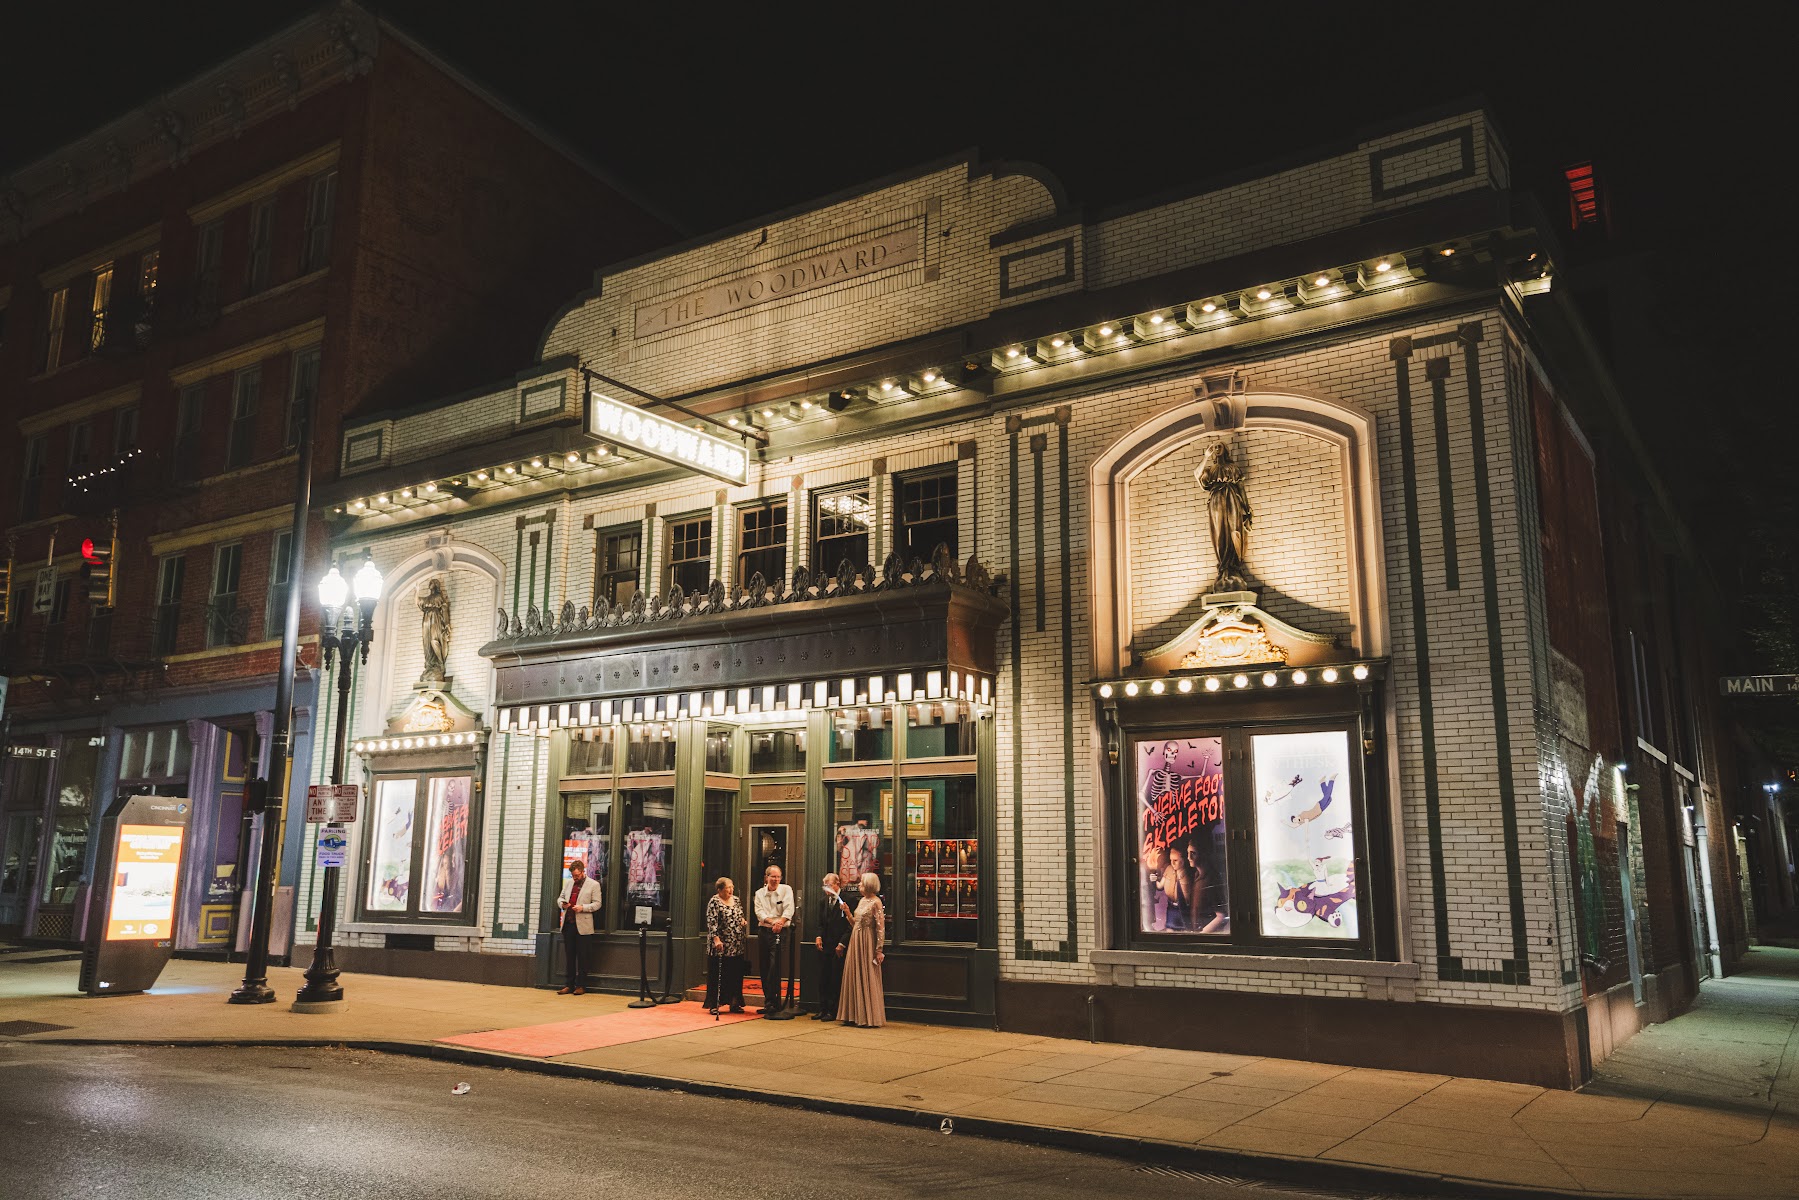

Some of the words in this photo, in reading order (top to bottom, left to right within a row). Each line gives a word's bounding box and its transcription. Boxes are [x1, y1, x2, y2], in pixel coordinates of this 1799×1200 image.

[660, 296, 705, 325] THE
[727, 243, 888, 305] WOODWARD
[597, 401, 745, 476] WOODWARD
[1727, 678, 1774, 693] MAIN
[1787, 683, 1799, 691] 14
[13, 746, 33, 756] 14TH
[36, 748, 48, 757] ST
[50, 749, 57, 758] E
[784, 785, 805, 800] 140
[312, 799, 327, 807] ANY
[1143, 780, 1192, 831] TWELVE
[312, 807, 327, 815] TIME
